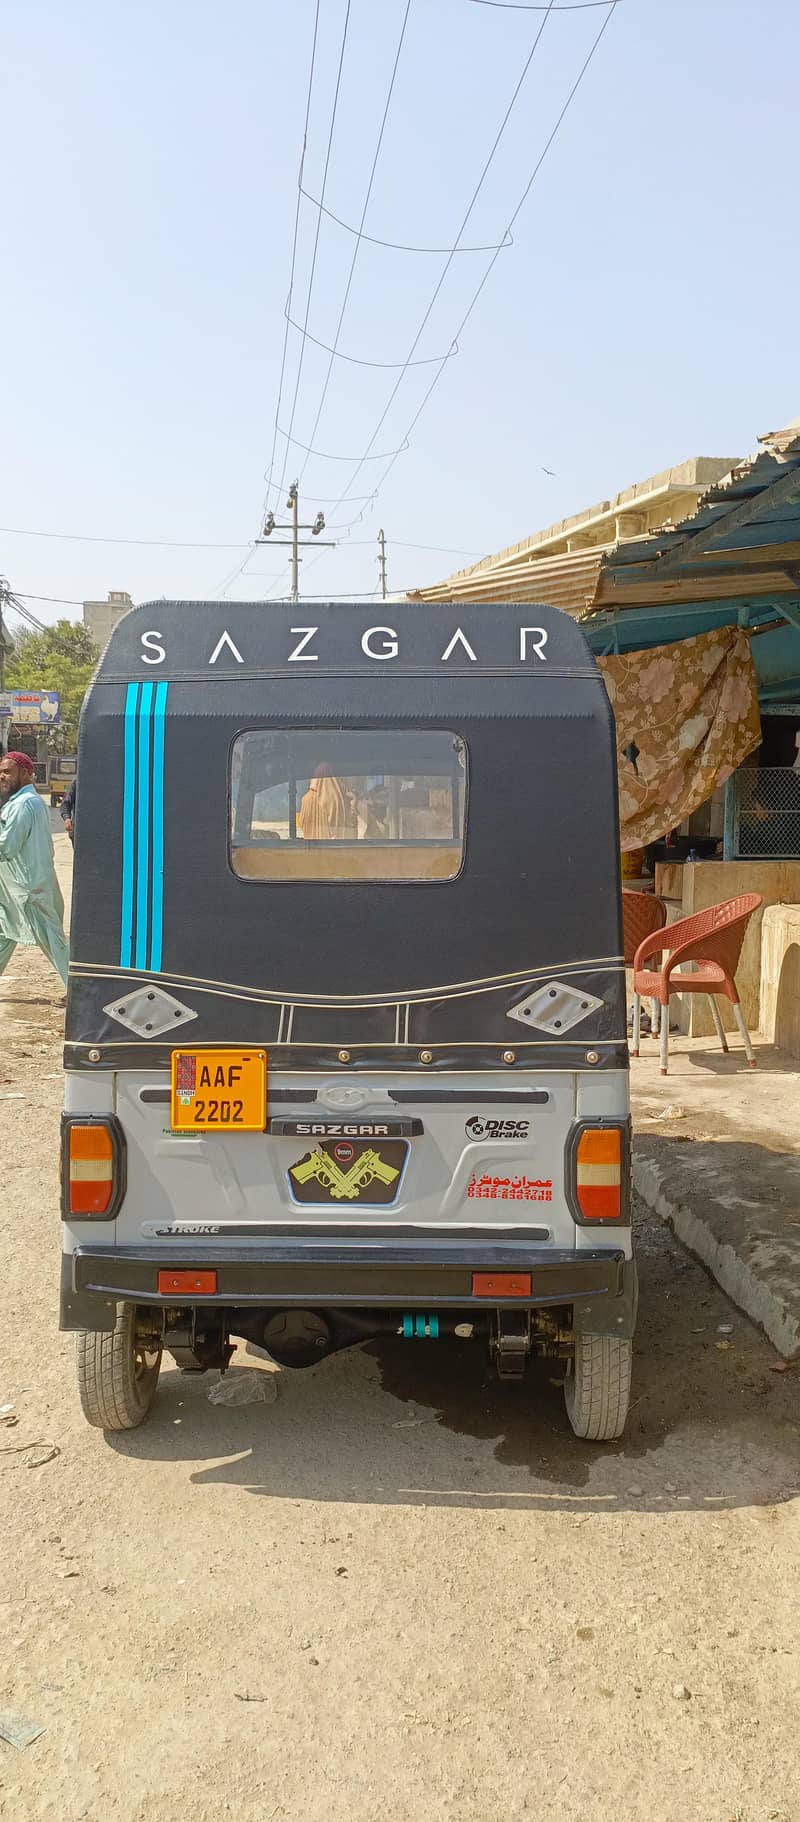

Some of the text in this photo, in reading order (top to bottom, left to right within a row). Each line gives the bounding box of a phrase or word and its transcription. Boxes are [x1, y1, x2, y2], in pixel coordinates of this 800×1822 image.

[140, 626, 548, 665] SAZGAR
[200, 1066, 242, 1087] AAF
[194, 1100, 244, 1122] 2202
[296, 1124, 389, 1135] SAZGAR
[485, 1120, 530, 1131] DISC
[489, 1130, 529, 1138] Brake
[511, 1175, 552, 1189] عمران
